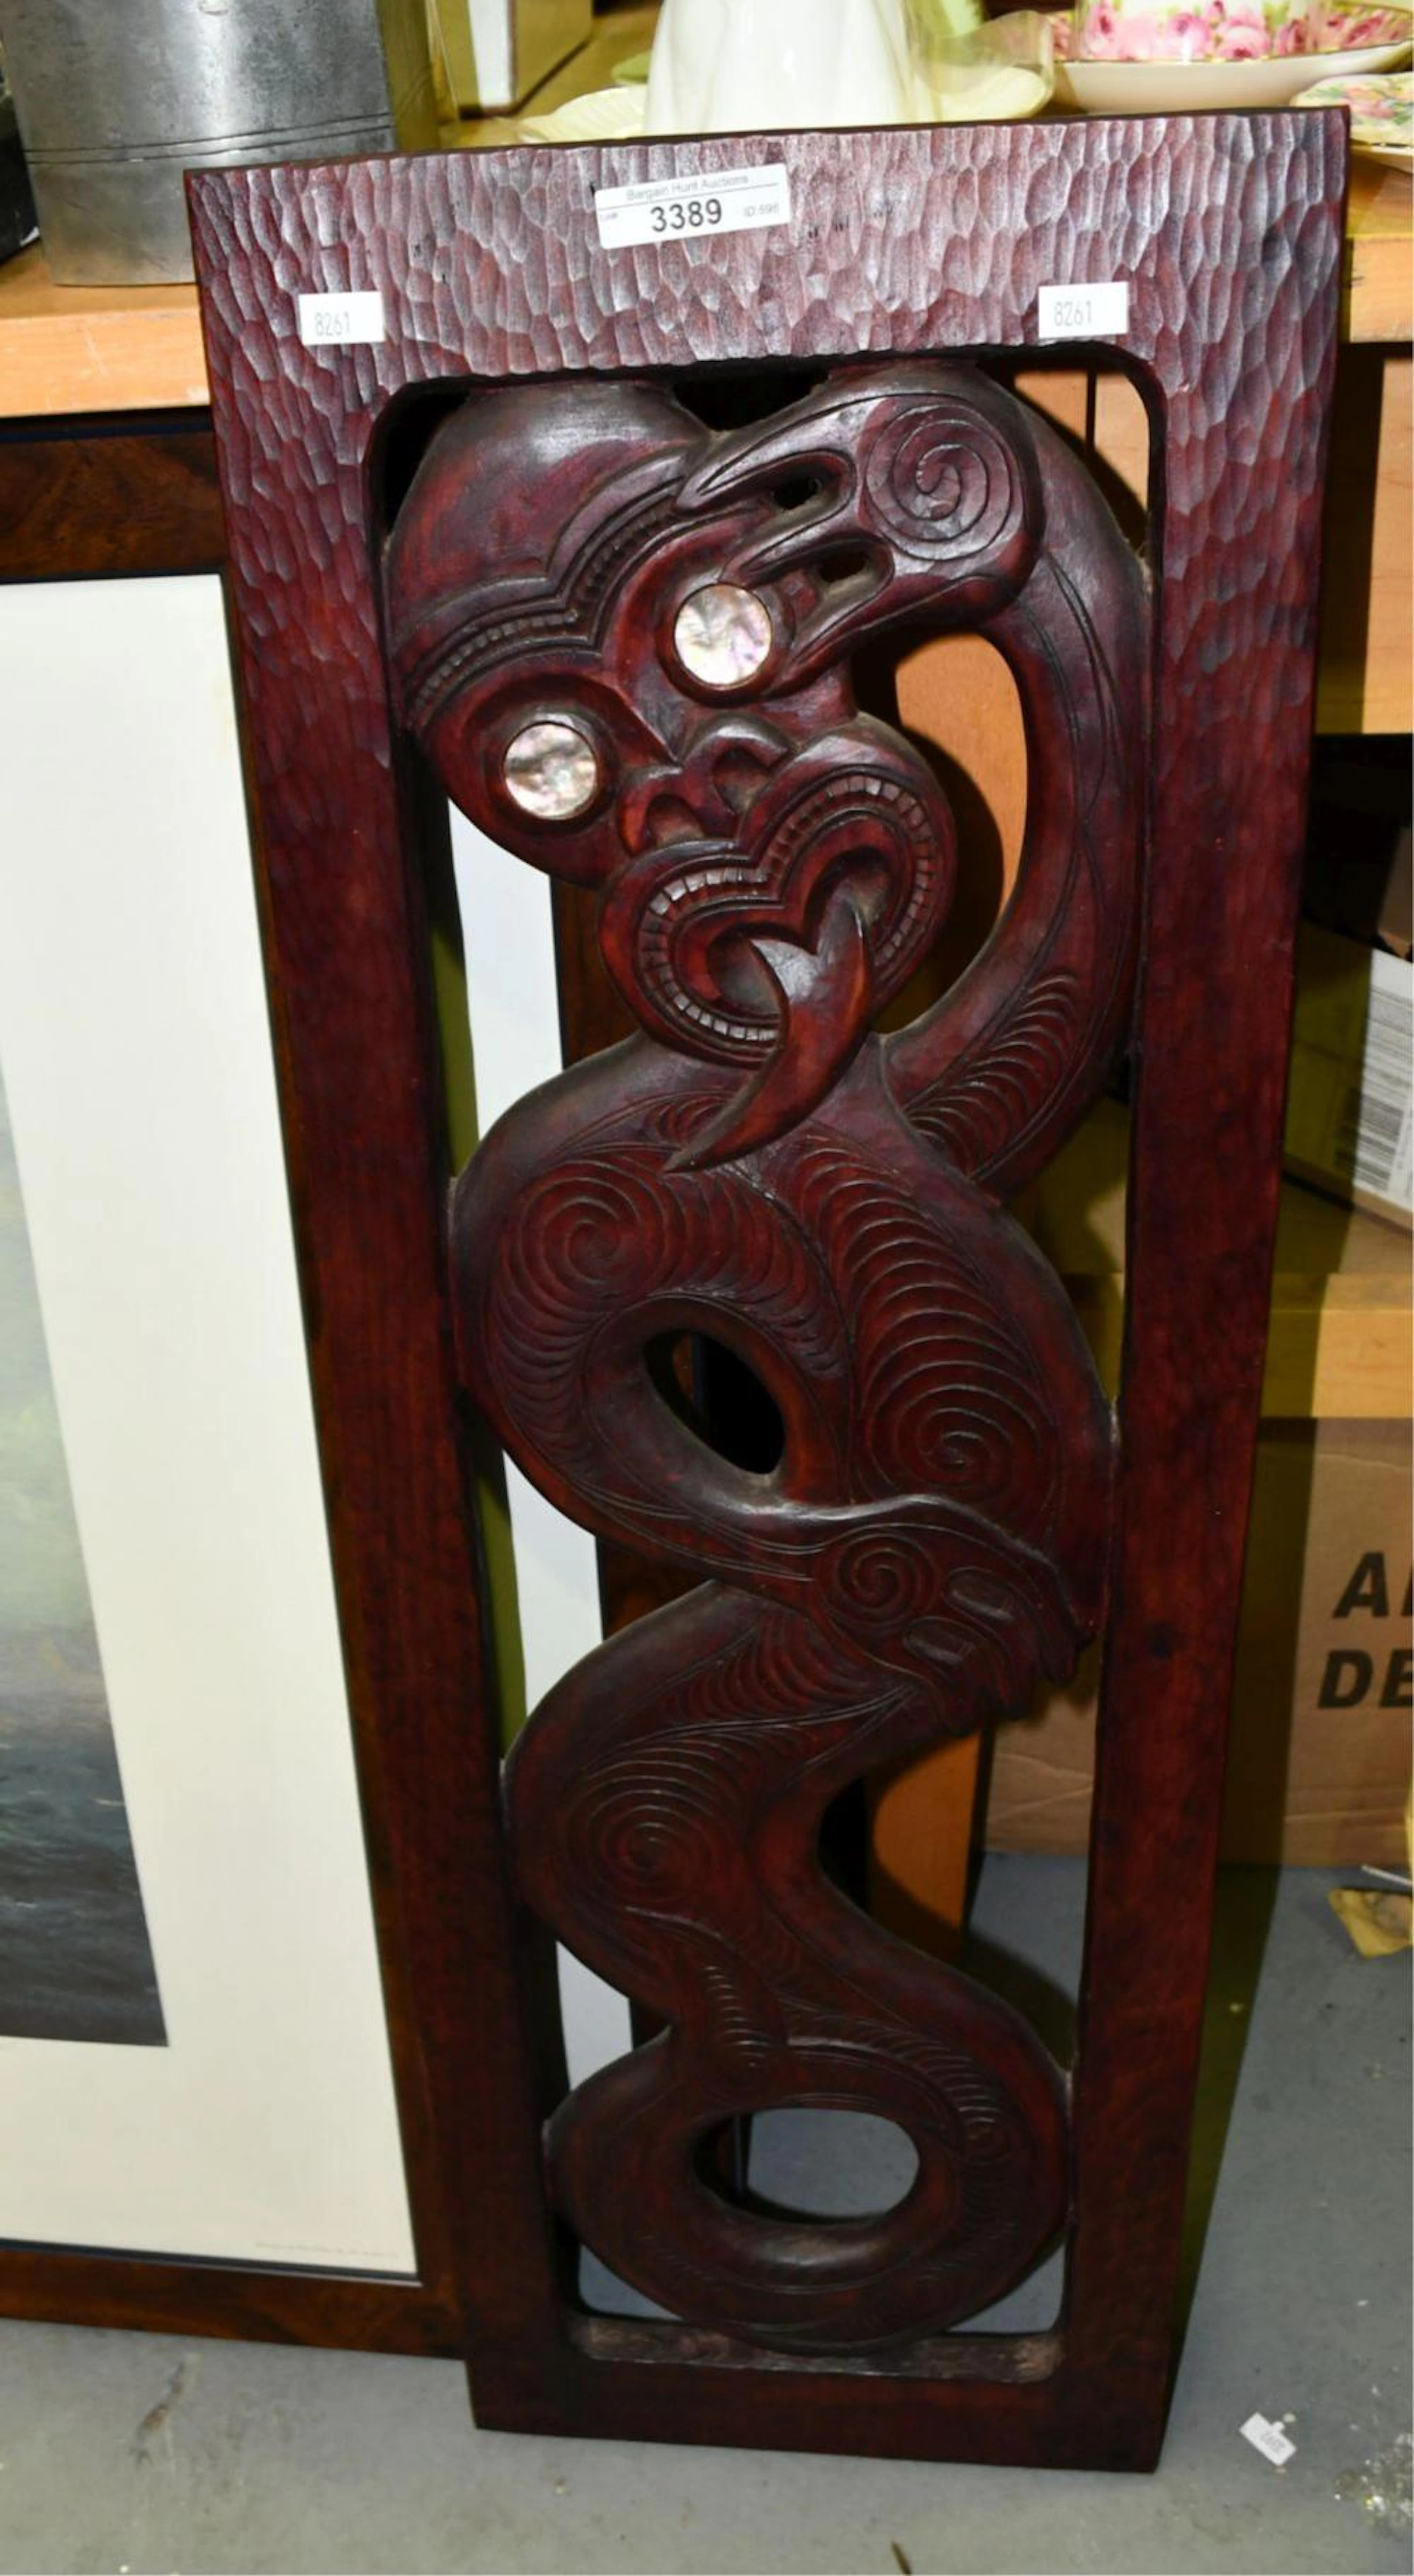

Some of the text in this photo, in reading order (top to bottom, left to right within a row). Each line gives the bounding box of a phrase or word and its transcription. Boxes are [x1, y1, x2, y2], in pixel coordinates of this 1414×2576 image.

[627, 175, 748, 203] Bargain Hunt Auctions
[650, 198, 723, 232] 3389
[314, 311, 350, 337] 8261
[1054, 300, 1092, 327] 8261
